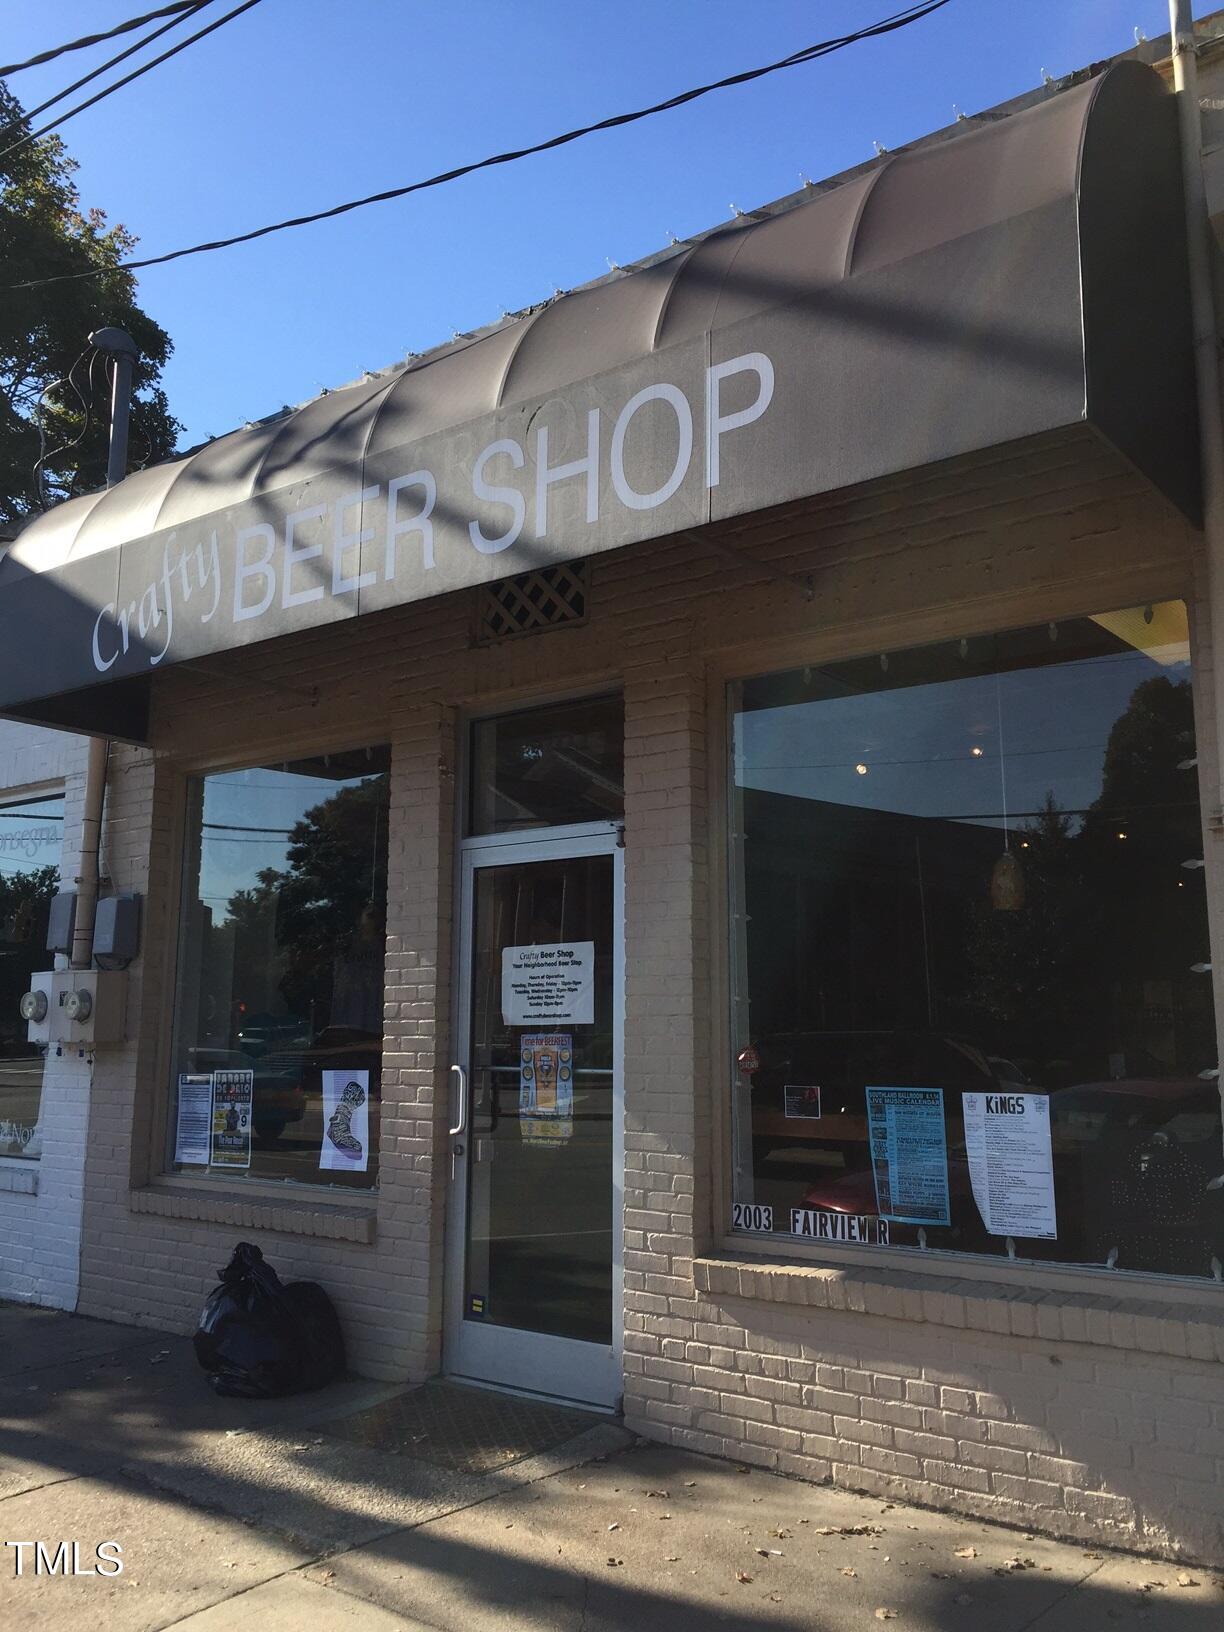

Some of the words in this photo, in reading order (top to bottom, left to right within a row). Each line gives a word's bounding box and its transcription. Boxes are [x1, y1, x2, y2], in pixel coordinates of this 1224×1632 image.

[93, 529, 221, 671] Crafty
[233, 470, 437, 622] BEER
[468, 352, 775, 554] SHOP
[520, 952, 539, 961] Crafty
[557, 950, 574, 958] Shop
[524, 961, 557, 969] Neighborhood
[884, 1097, 905, 1105] MUSIC
[905, 1098, 940, 1106] CALENDAR
[733, 1205, 772, 1230] 2003
[791, 1209, 867, 1242] FAIRVIEW
[878, 1219, 888, 1245] R
